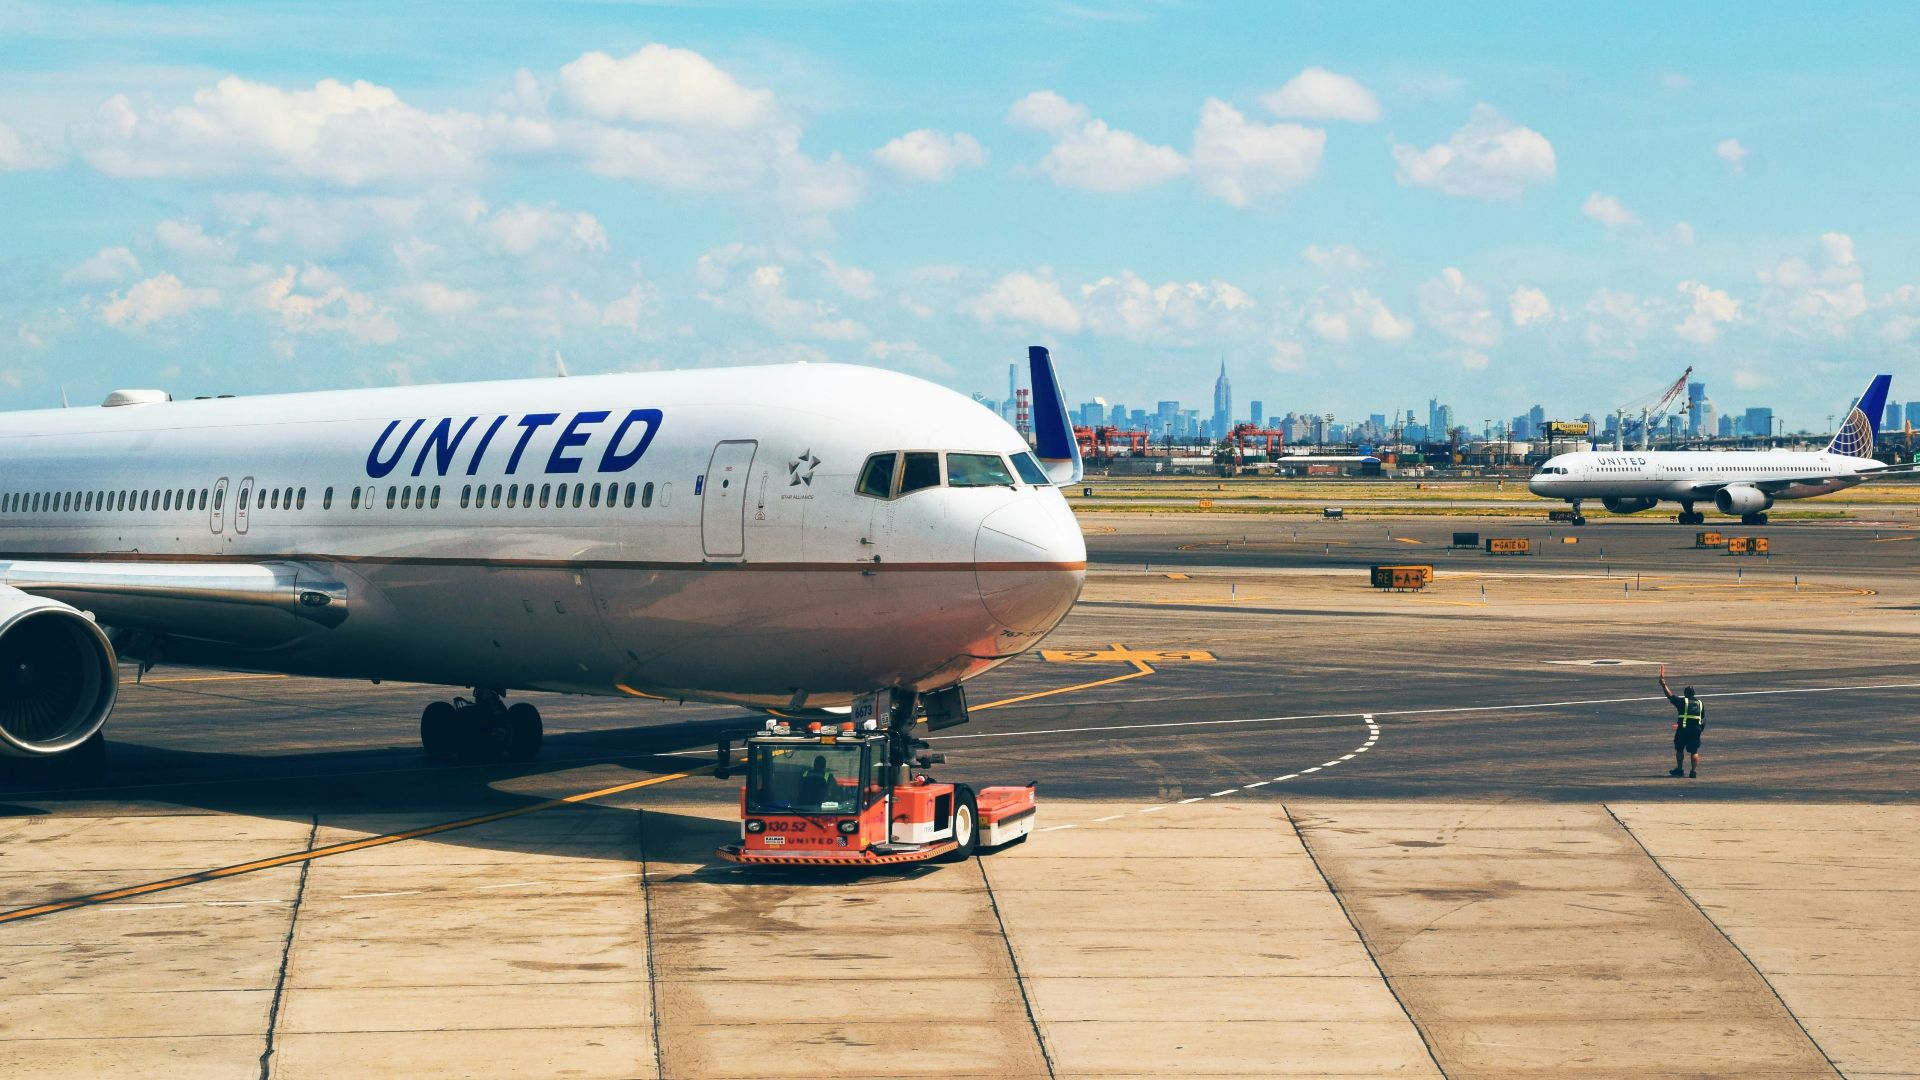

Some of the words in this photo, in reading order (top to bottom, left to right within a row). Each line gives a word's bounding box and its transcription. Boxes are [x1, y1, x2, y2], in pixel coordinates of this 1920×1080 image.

[366, 408, 664, 479] UNITED
[1597, 457, 1646, 466] UNITED
[1500, 541, 1516, 550] GATE
[1377, 572, 1390, 584] RE
[1403, 572, 1411, 584] A
[855, 704, 873, 718] 6673
[768, 821, 807, 833] 130.52
[788, 837, 834, 845] UNITED
